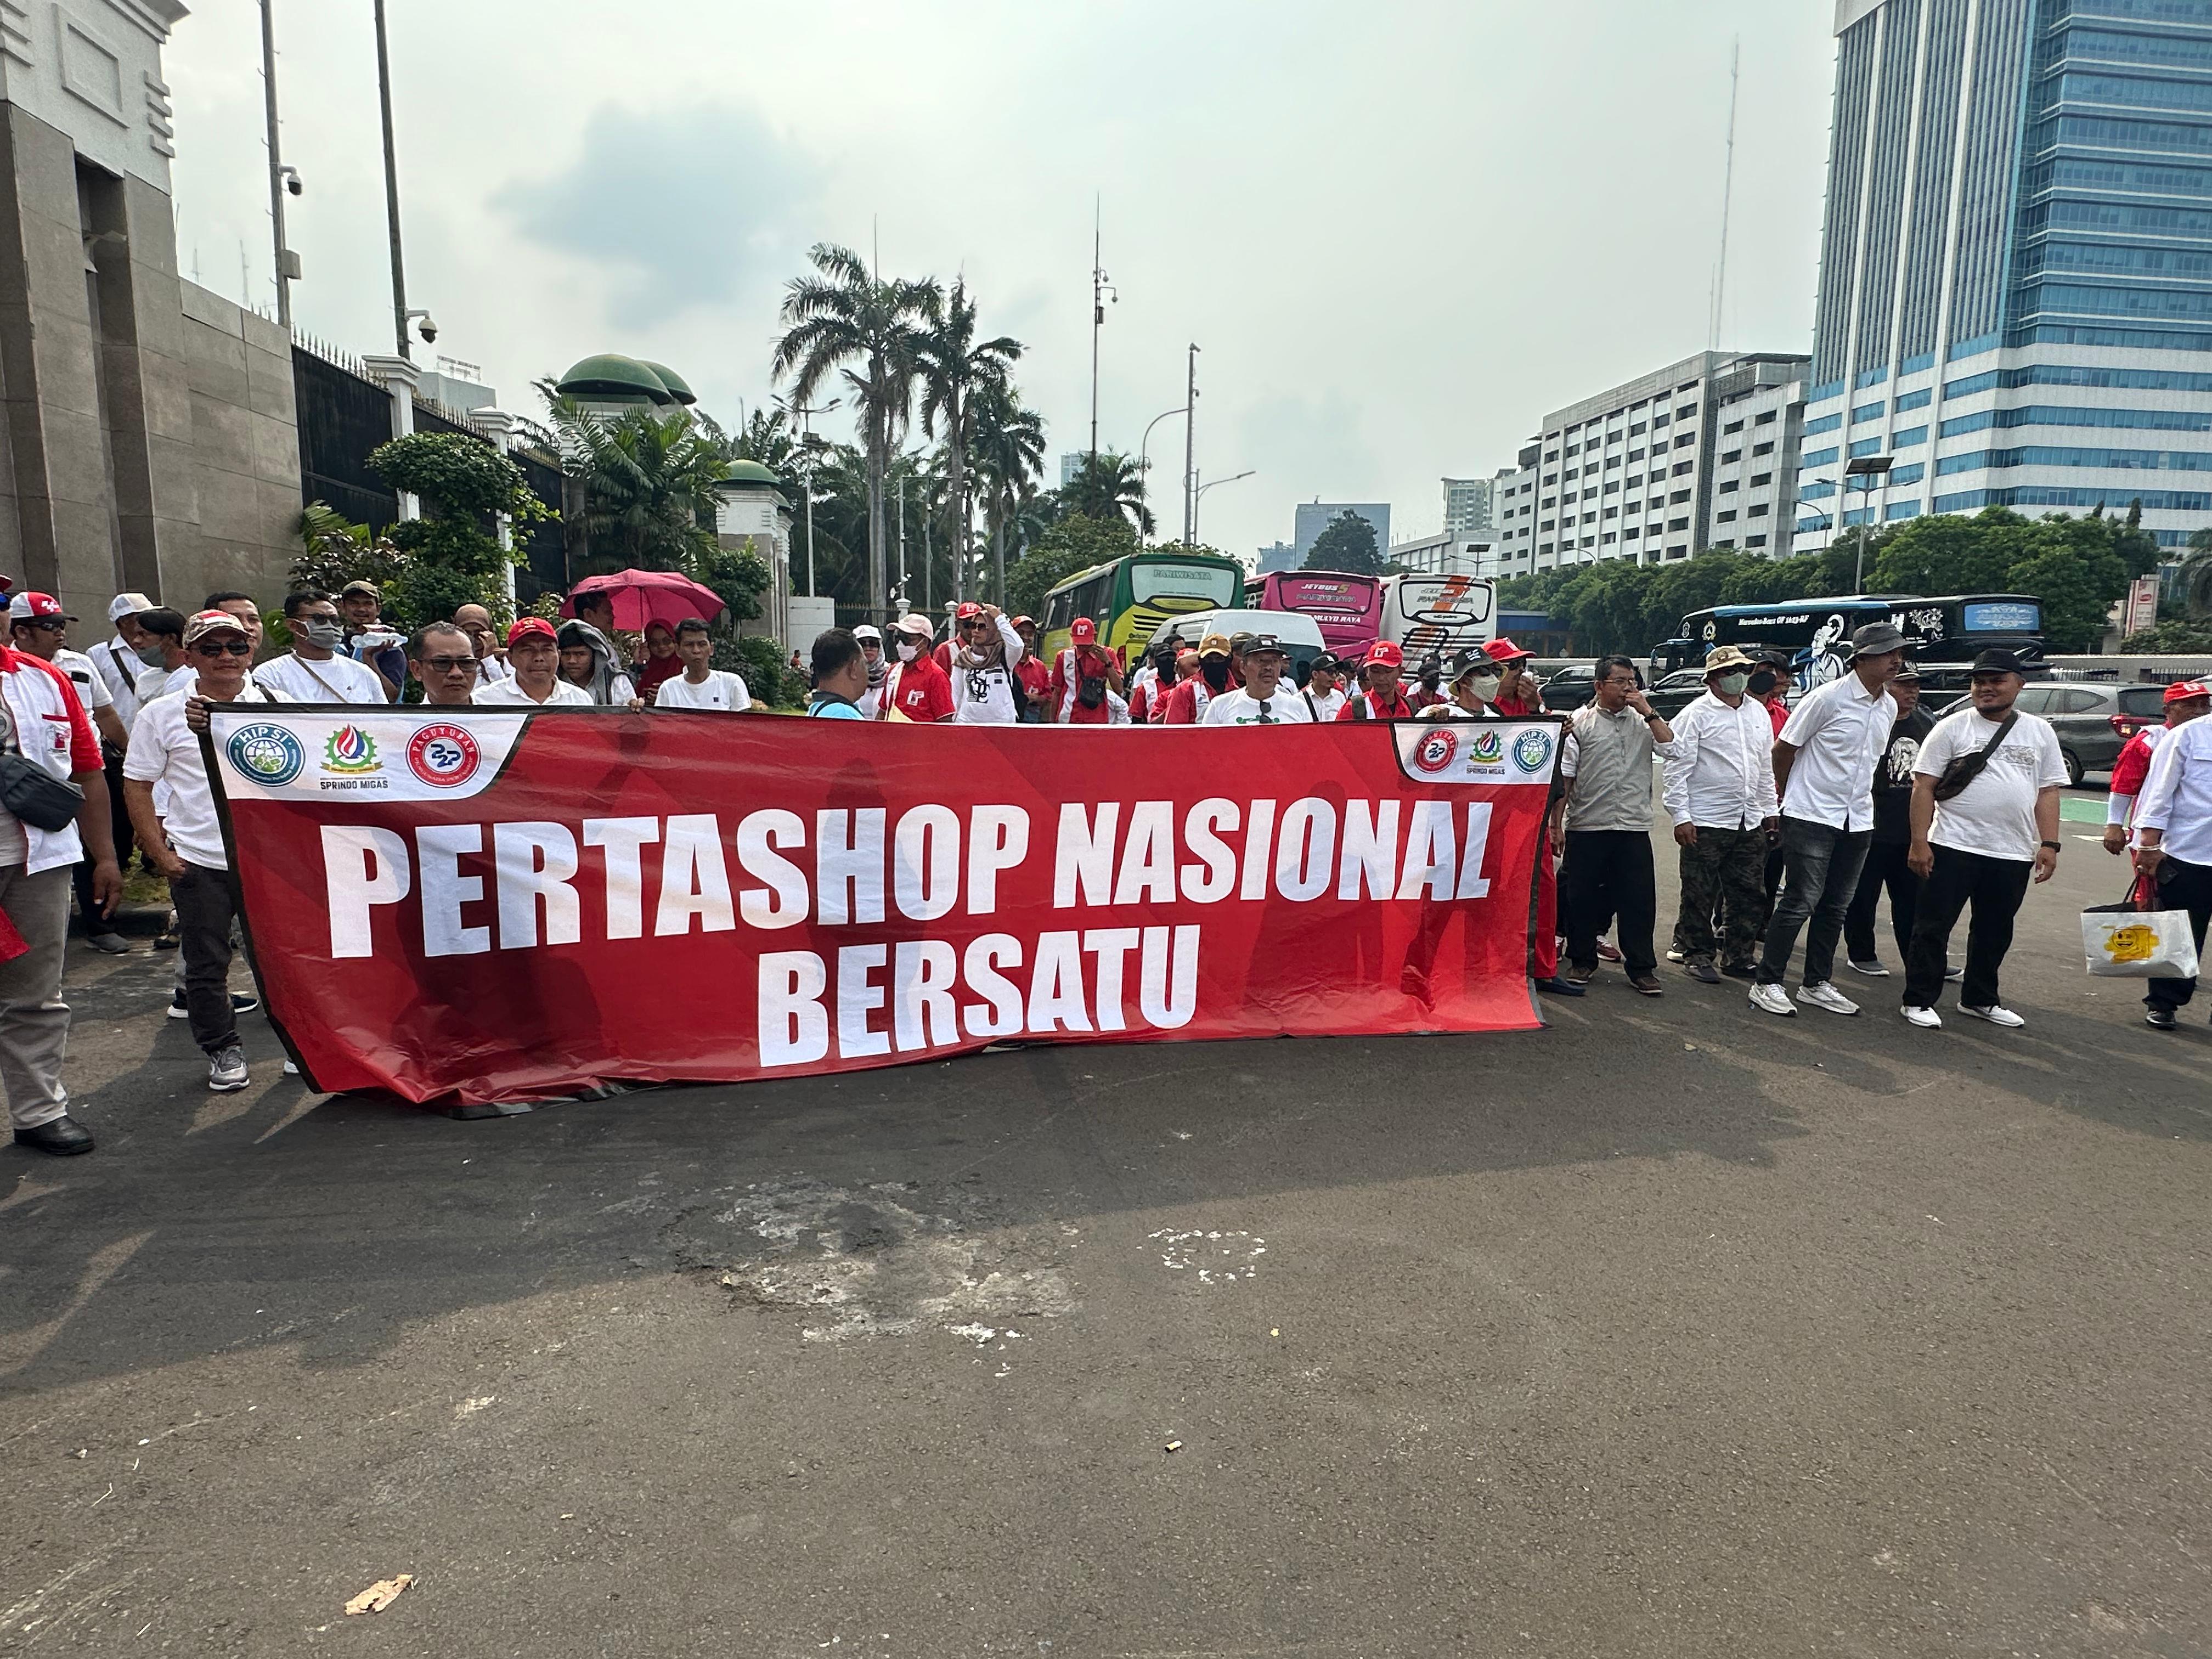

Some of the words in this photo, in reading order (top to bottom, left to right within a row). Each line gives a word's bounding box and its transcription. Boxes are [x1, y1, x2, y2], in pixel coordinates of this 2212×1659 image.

[1153, 569, 1212, 580] PARIWISATA
[412, 727, 476, 753] PAGUYUBAN
[320, 780, 358, 790] SPRINDO
[359, 780, 389, 789] MIGAS
[320, 804, 1029, 958] PERTASHOP
[1053, 797, 1493, 908] NASIONAL
[758, 924, 1200, 1068] BERSATU
